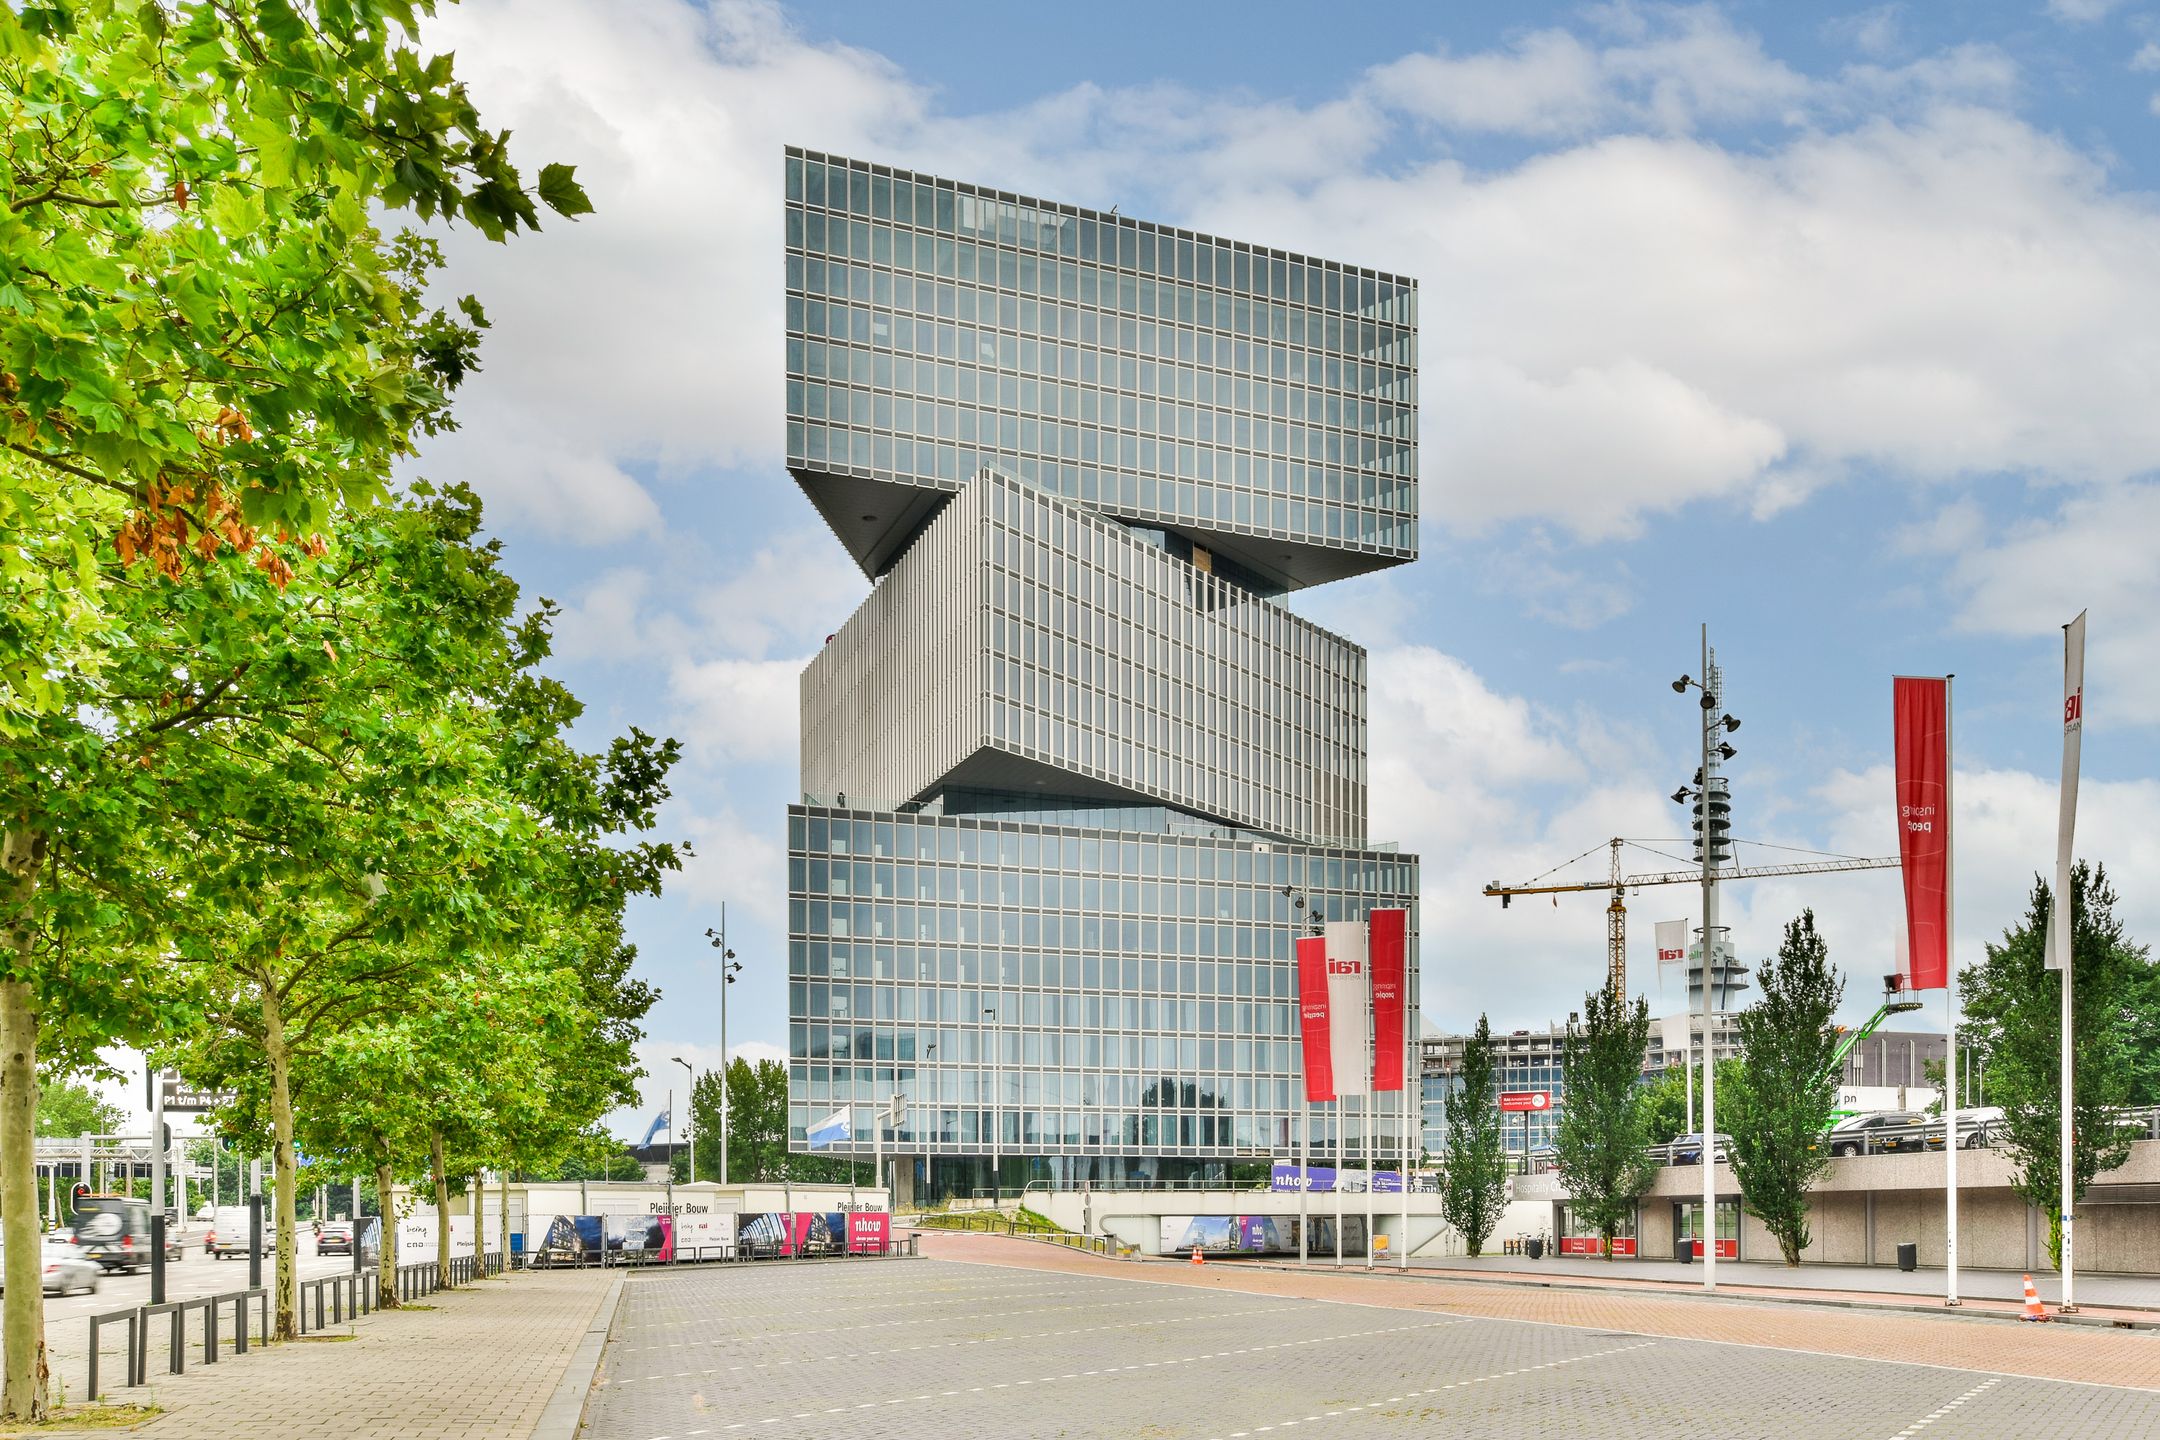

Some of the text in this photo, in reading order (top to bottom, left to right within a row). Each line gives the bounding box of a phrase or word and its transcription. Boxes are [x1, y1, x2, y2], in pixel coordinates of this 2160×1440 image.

[686, 1203, 709, 1213] Bouw
[865, 1202, 883, 1212] Bouw
[855, 1218, 881, 1232] nhow
